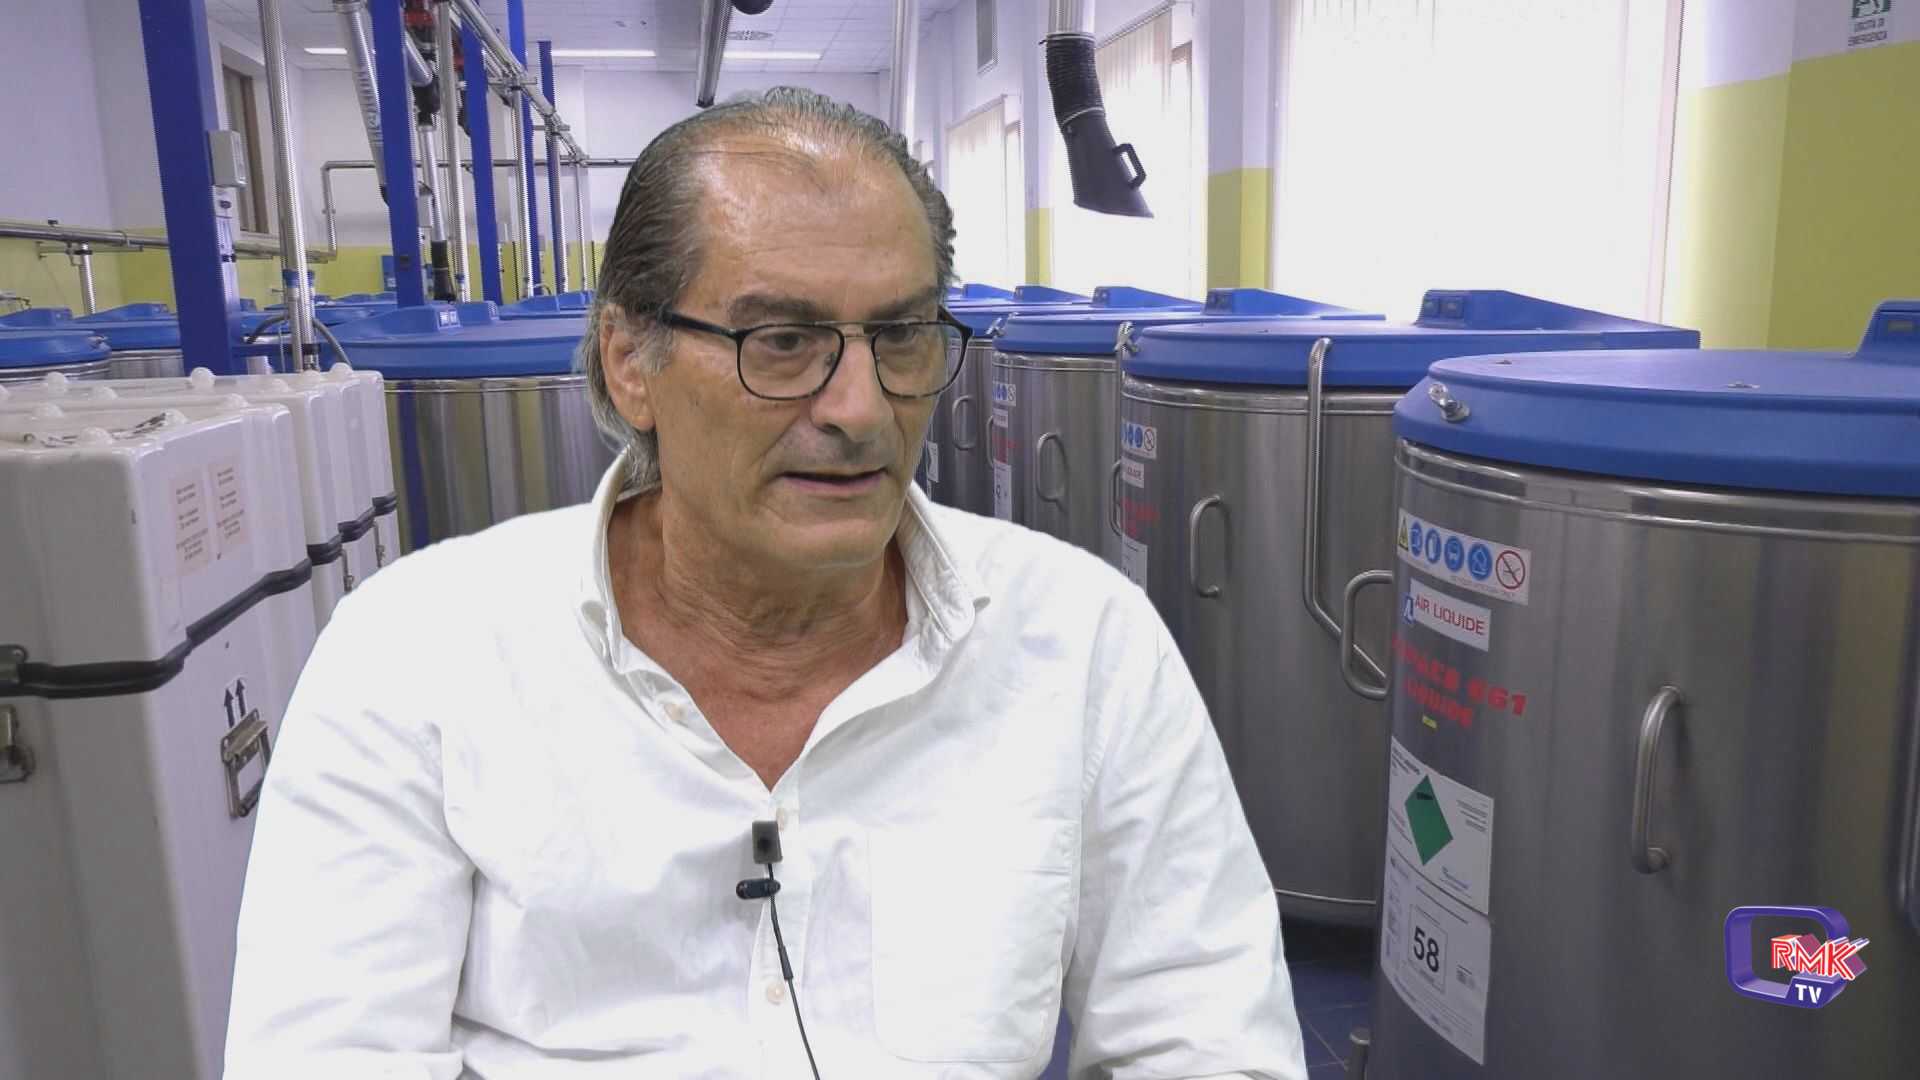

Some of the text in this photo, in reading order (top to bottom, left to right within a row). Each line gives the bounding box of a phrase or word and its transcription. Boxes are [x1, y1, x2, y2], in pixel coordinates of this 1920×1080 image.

[1415, 594, 1485, 636] AIR LIQUIDE
[1413, 926, 1440, 973] 58
